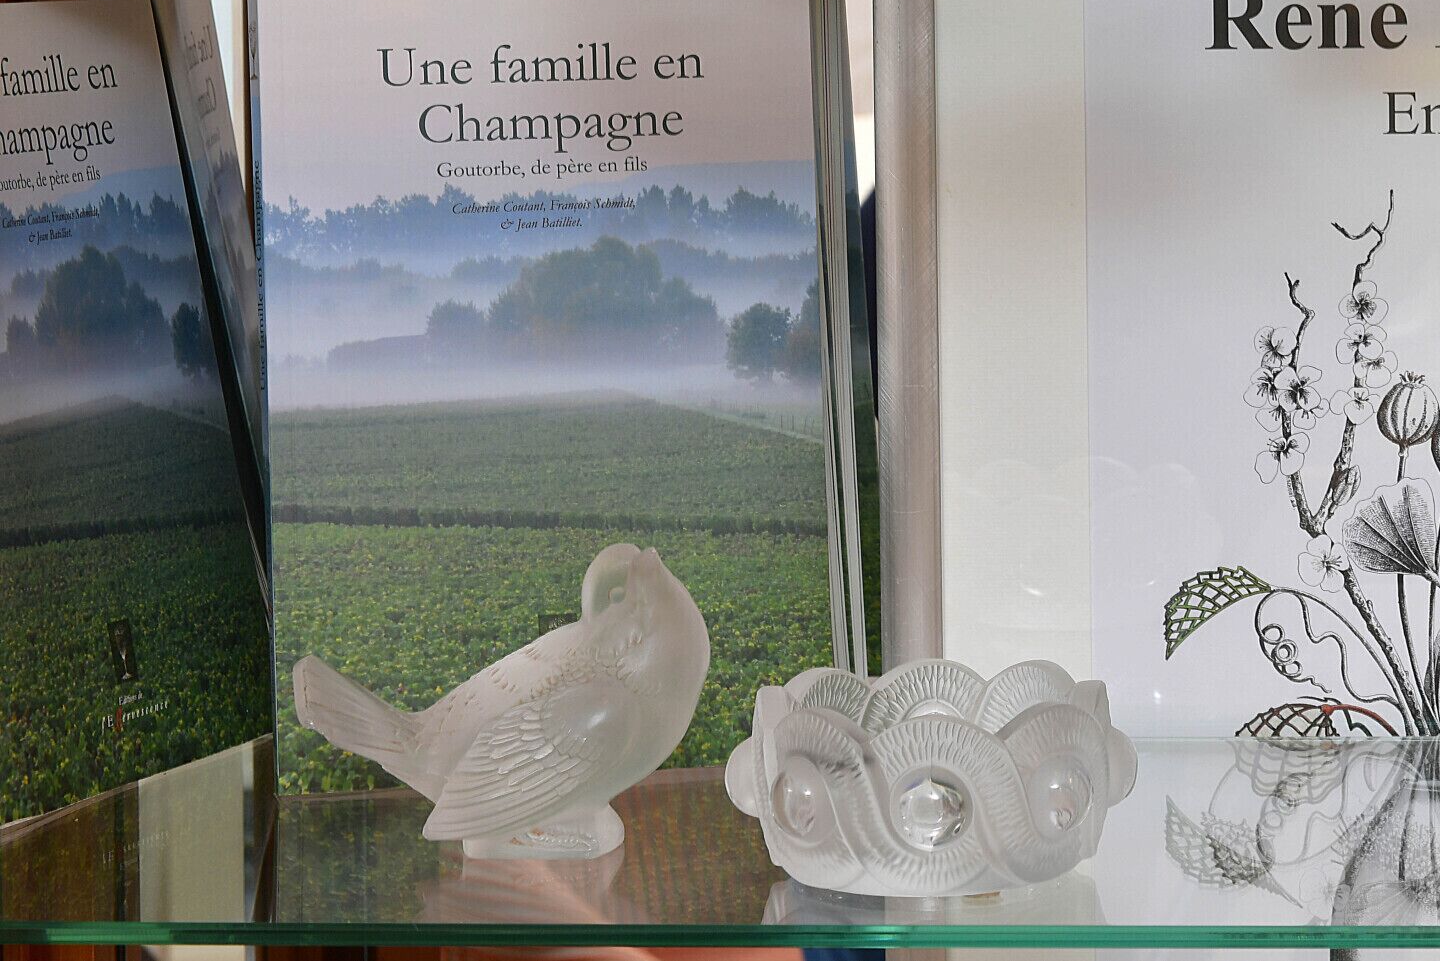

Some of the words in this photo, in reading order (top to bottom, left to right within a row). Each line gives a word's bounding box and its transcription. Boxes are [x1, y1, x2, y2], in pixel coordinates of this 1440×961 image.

[0, 54, 80, 96] famille
[87, 64, 118, 89] en
[377, 48, 473, 87] Une
[490, 43, 637, 83] famille
[653, 53, 705, 79] en
[0, 120, 115, 165] ampagne
[418, 103, 684, 153] Champagne
[0, 173, 35, 192] outorbe,
[36, 172, 47, 187] de
[49, 170, 70, 191] père
[71, 172, 84, 183] en
[86, 166, 101, 182] fils
[437, 161, 526, 178] Goutorbe,
[531, 160, 551, 175] de
[556, 157, 593, 179] père
[598, 160, 618, 172] en
[623, 156, 648, 172] fils
[254, 159, 263, 263] Champagne
[452, 201, 500, 214] Catherine
[503, 199, 546, 213] Coutant,
[549, 198, 592, 213] François
[593, 197, 636, 209] Schmidt,
[501, 219, 514, 230] &
[515, 218, 538, 232] Jean
